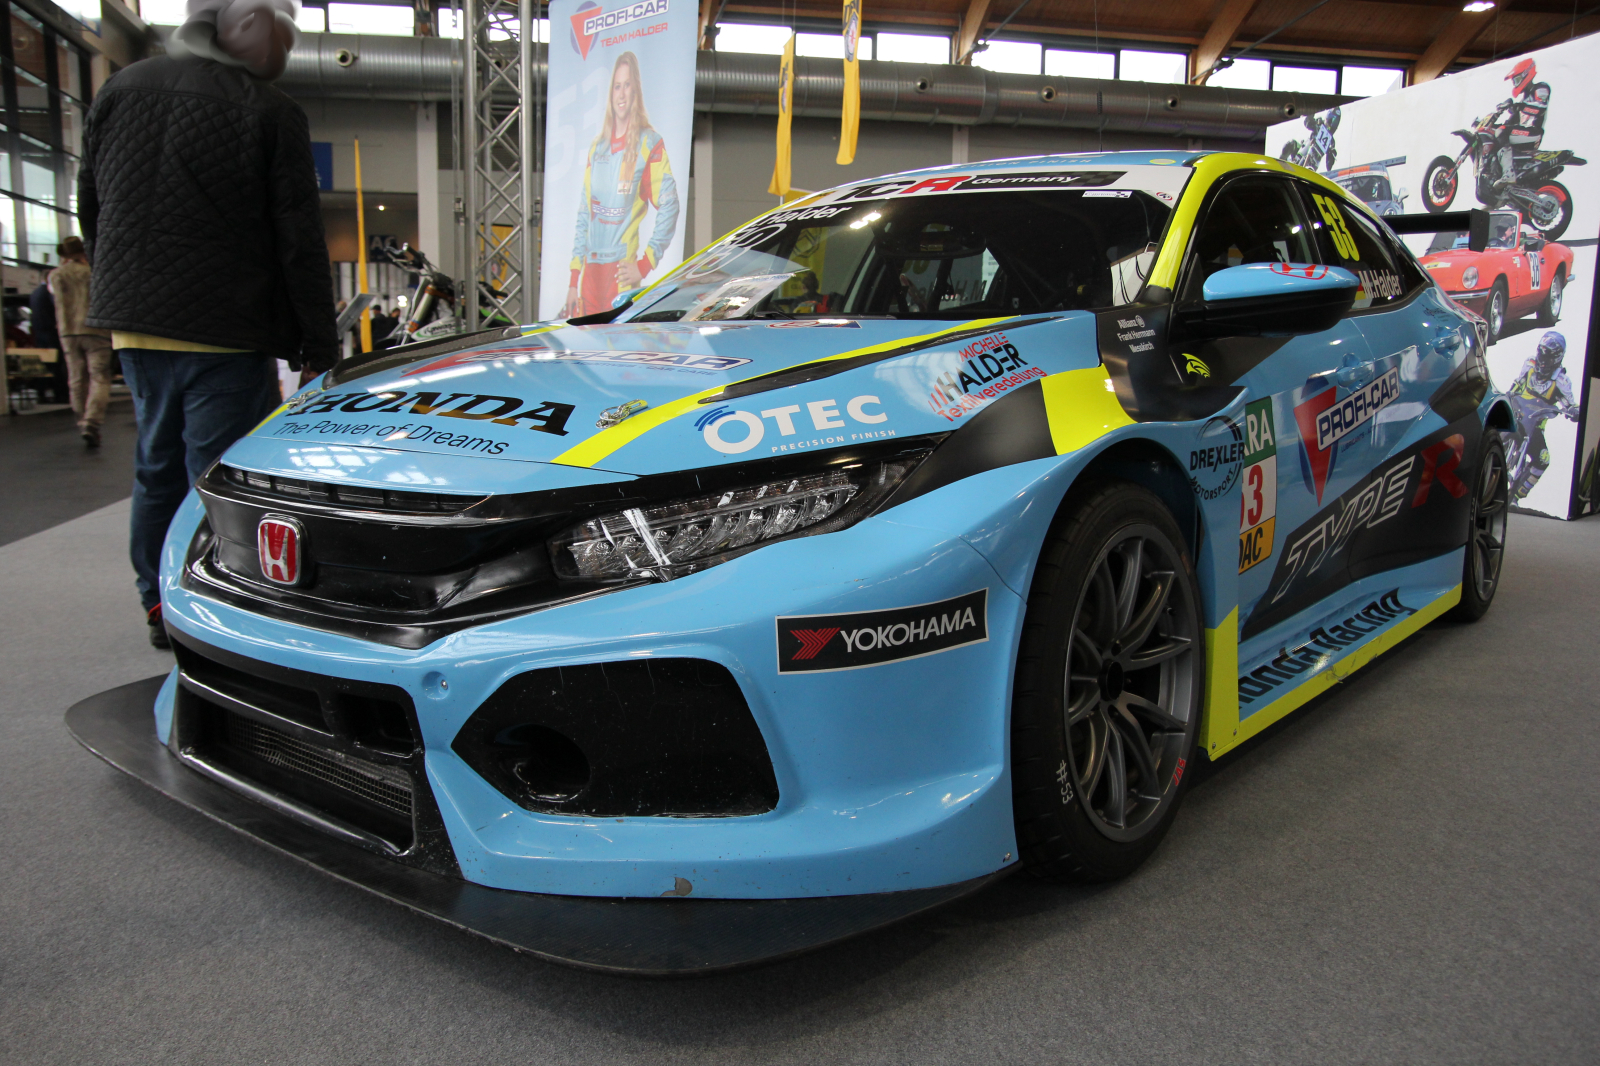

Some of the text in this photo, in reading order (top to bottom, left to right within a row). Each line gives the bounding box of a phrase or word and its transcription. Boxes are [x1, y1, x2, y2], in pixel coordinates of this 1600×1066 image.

[585, 0, 668, 34] PROFI-CAR
[600, 22, 669, 48] TEAM HALDER
[834, 173, 1080, 202] TCR Germany
[1311, 193, 1360, 262] 53
[958, 331, 1009, 362] MICHELLE
[936, 343, 1029, 402] HALDER
[937, 366, 1048, 422] Textilveredelung
[285, 390, 576, 437] HONDA
[700, 394, 889, 455] OTEC
[1318, 371, 1399, 446] PROFI-CAR
[273, 420, 510, 455] The Power of Dreams
[771, 429, 896, 453] PRECISION FINISH
[1189, 441, 1245, 473] DREXLER
[1190, 467, 1235, 500] MOTORSPORT
[1411, 433, 1469, 509] R
[1239, 464, 1264, 530] 3
[840, 606, 976, 653] YOKOHAMA
[1309, 586, 1419, 652] Racing
[1055, 759, 1074, 805] #53
[1172, 757, 1187, 787] JAS
